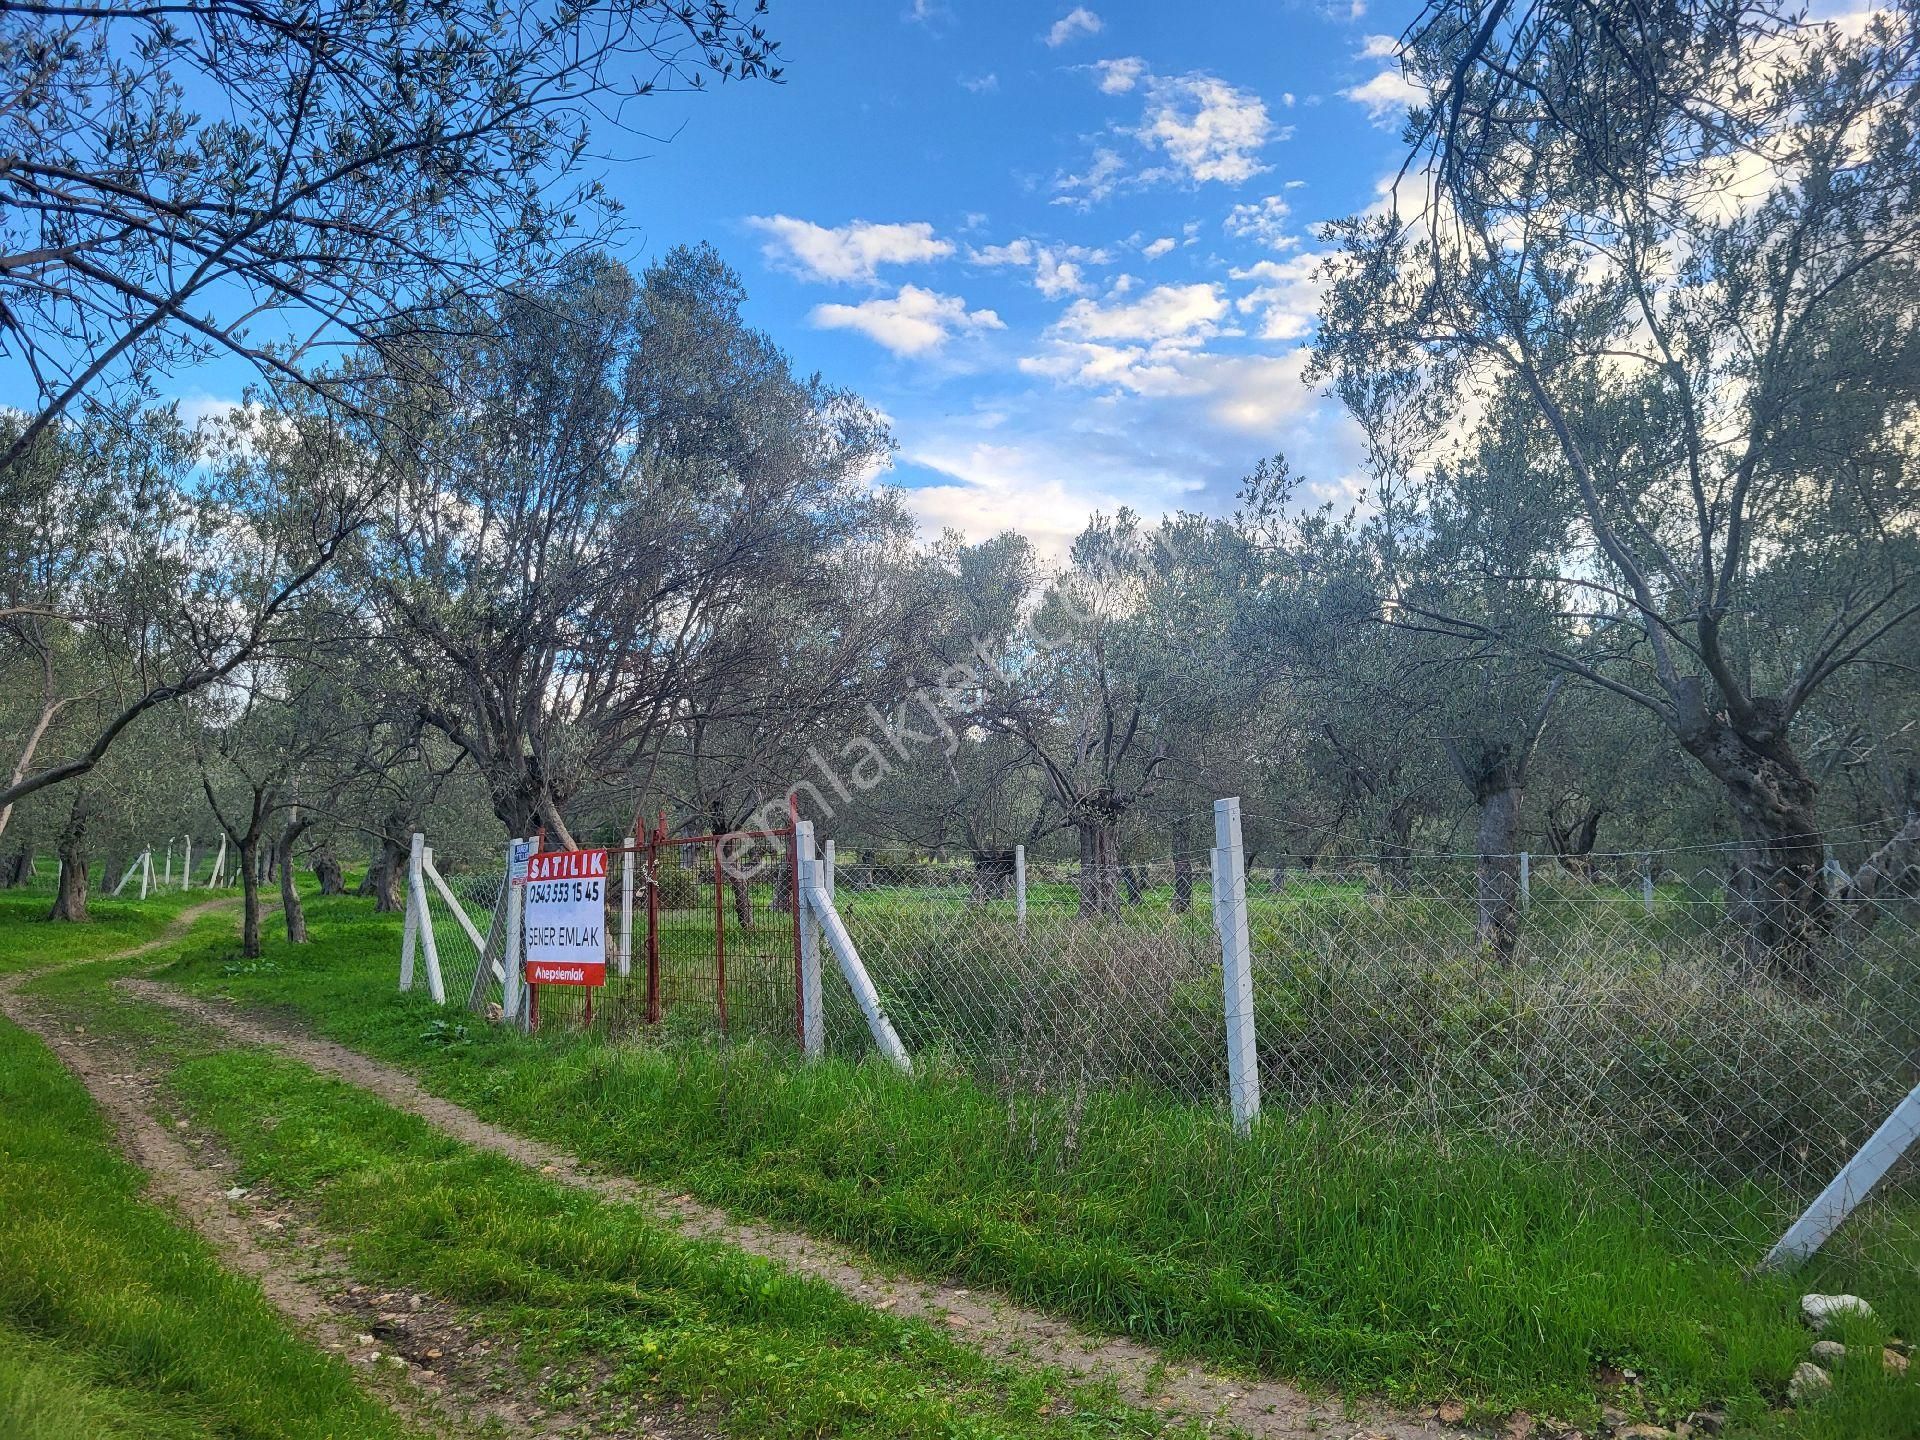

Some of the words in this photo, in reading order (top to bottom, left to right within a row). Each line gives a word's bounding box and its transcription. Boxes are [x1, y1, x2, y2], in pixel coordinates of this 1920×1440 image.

[530, 853, 603, 878] SATILIK
[572, 881, 582, 902] 15
[585, 881, 599, 901] 45
[529, 927, 555, 949] ŞENER
[559, 926, 599, 947] EMLAK
